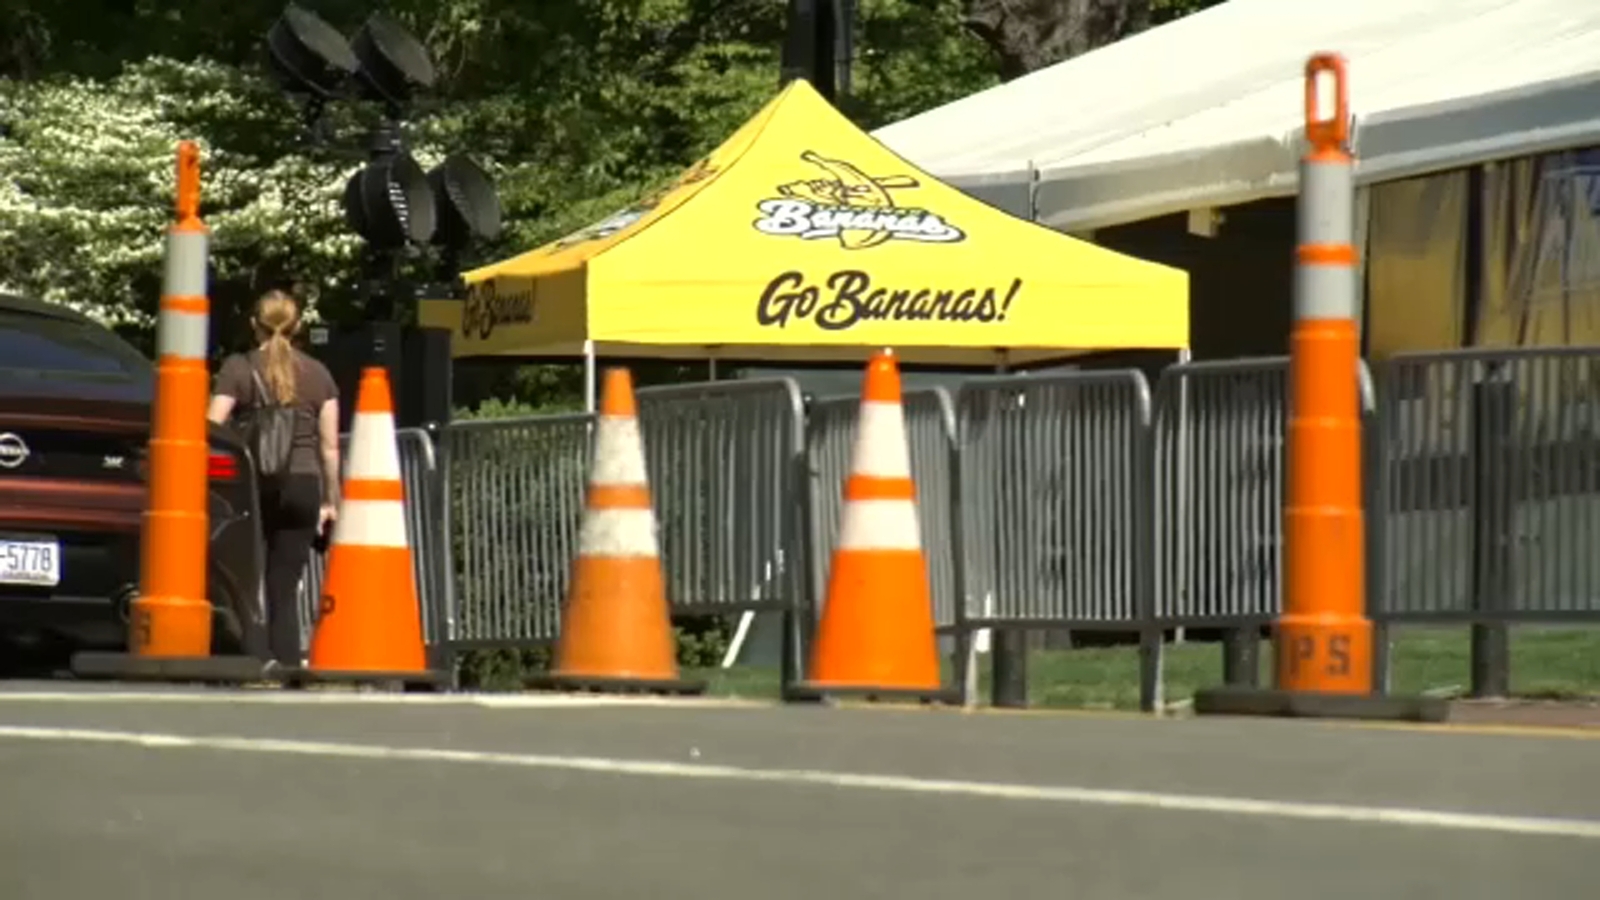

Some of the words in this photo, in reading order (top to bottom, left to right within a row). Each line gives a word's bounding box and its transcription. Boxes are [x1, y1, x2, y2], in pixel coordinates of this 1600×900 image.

[753, 198, 966, 243] Bananas
[757, 271, 819, 328] Go
[815, 270, 1022, 330] Bananas!
